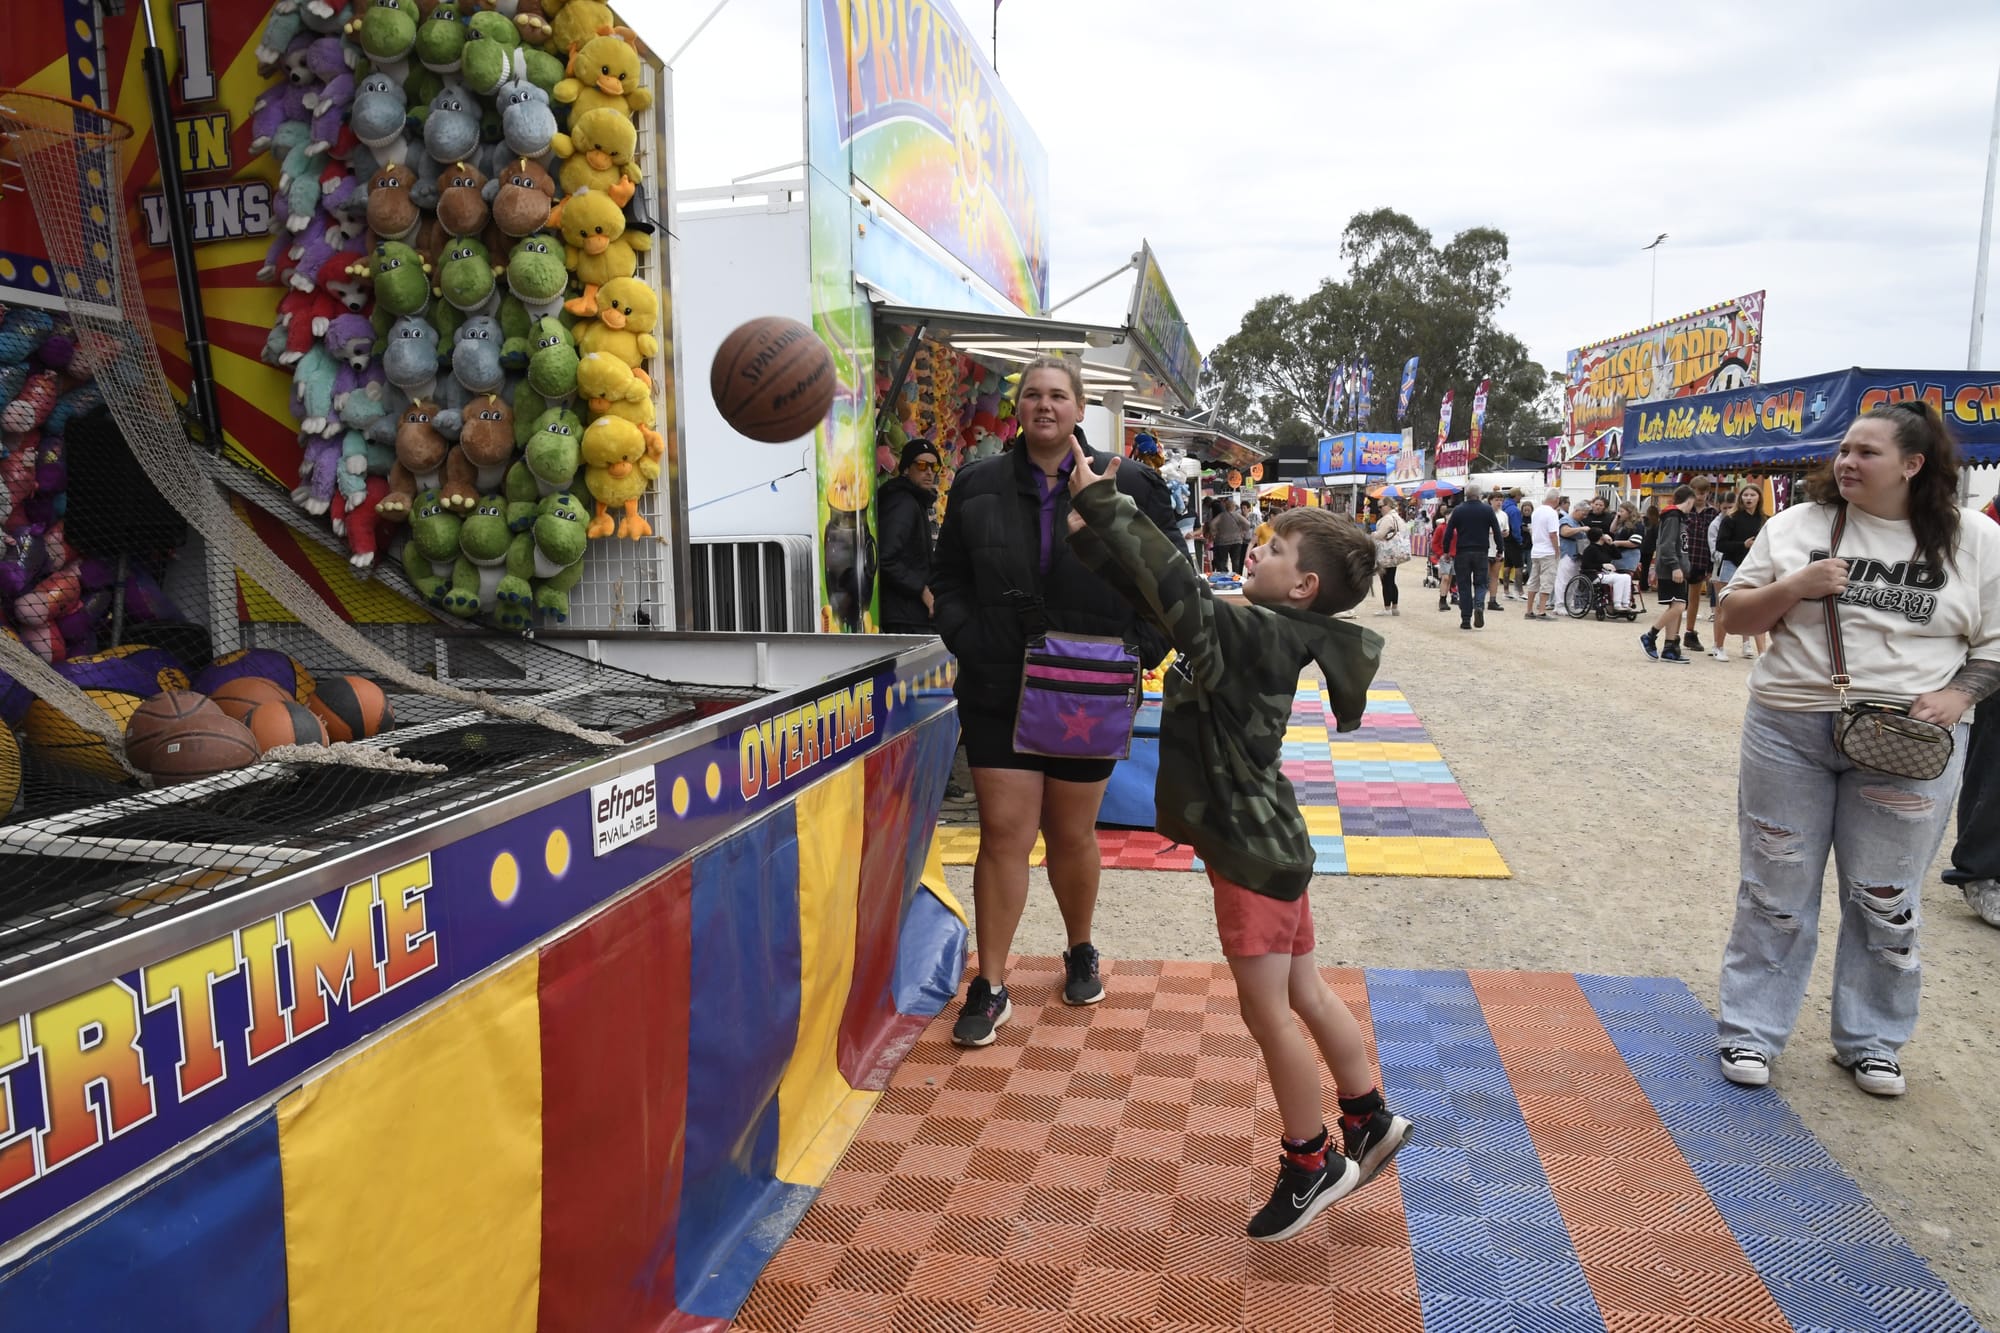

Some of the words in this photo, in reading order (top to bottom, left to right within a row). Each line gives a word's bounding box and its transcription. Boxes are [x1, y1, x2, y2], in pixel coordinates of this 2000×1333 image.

[178, 1, 215, 101] 1
[176, 115, 229, 173] IN
[1590, 341, 1650, 401] MUSIC
[1665, 327, 1728, 389] TRIP
[1664, 406, 1697, 441] Ride
[1696, 404, 1721, 435] the
[1722, 390, 1805, 438] CHA-CHA
[739, 677, 876, 802] OVERTIME
[596, 779, 656, 824] eftpos
[598, 809, 656, 850] AVAILABLE
